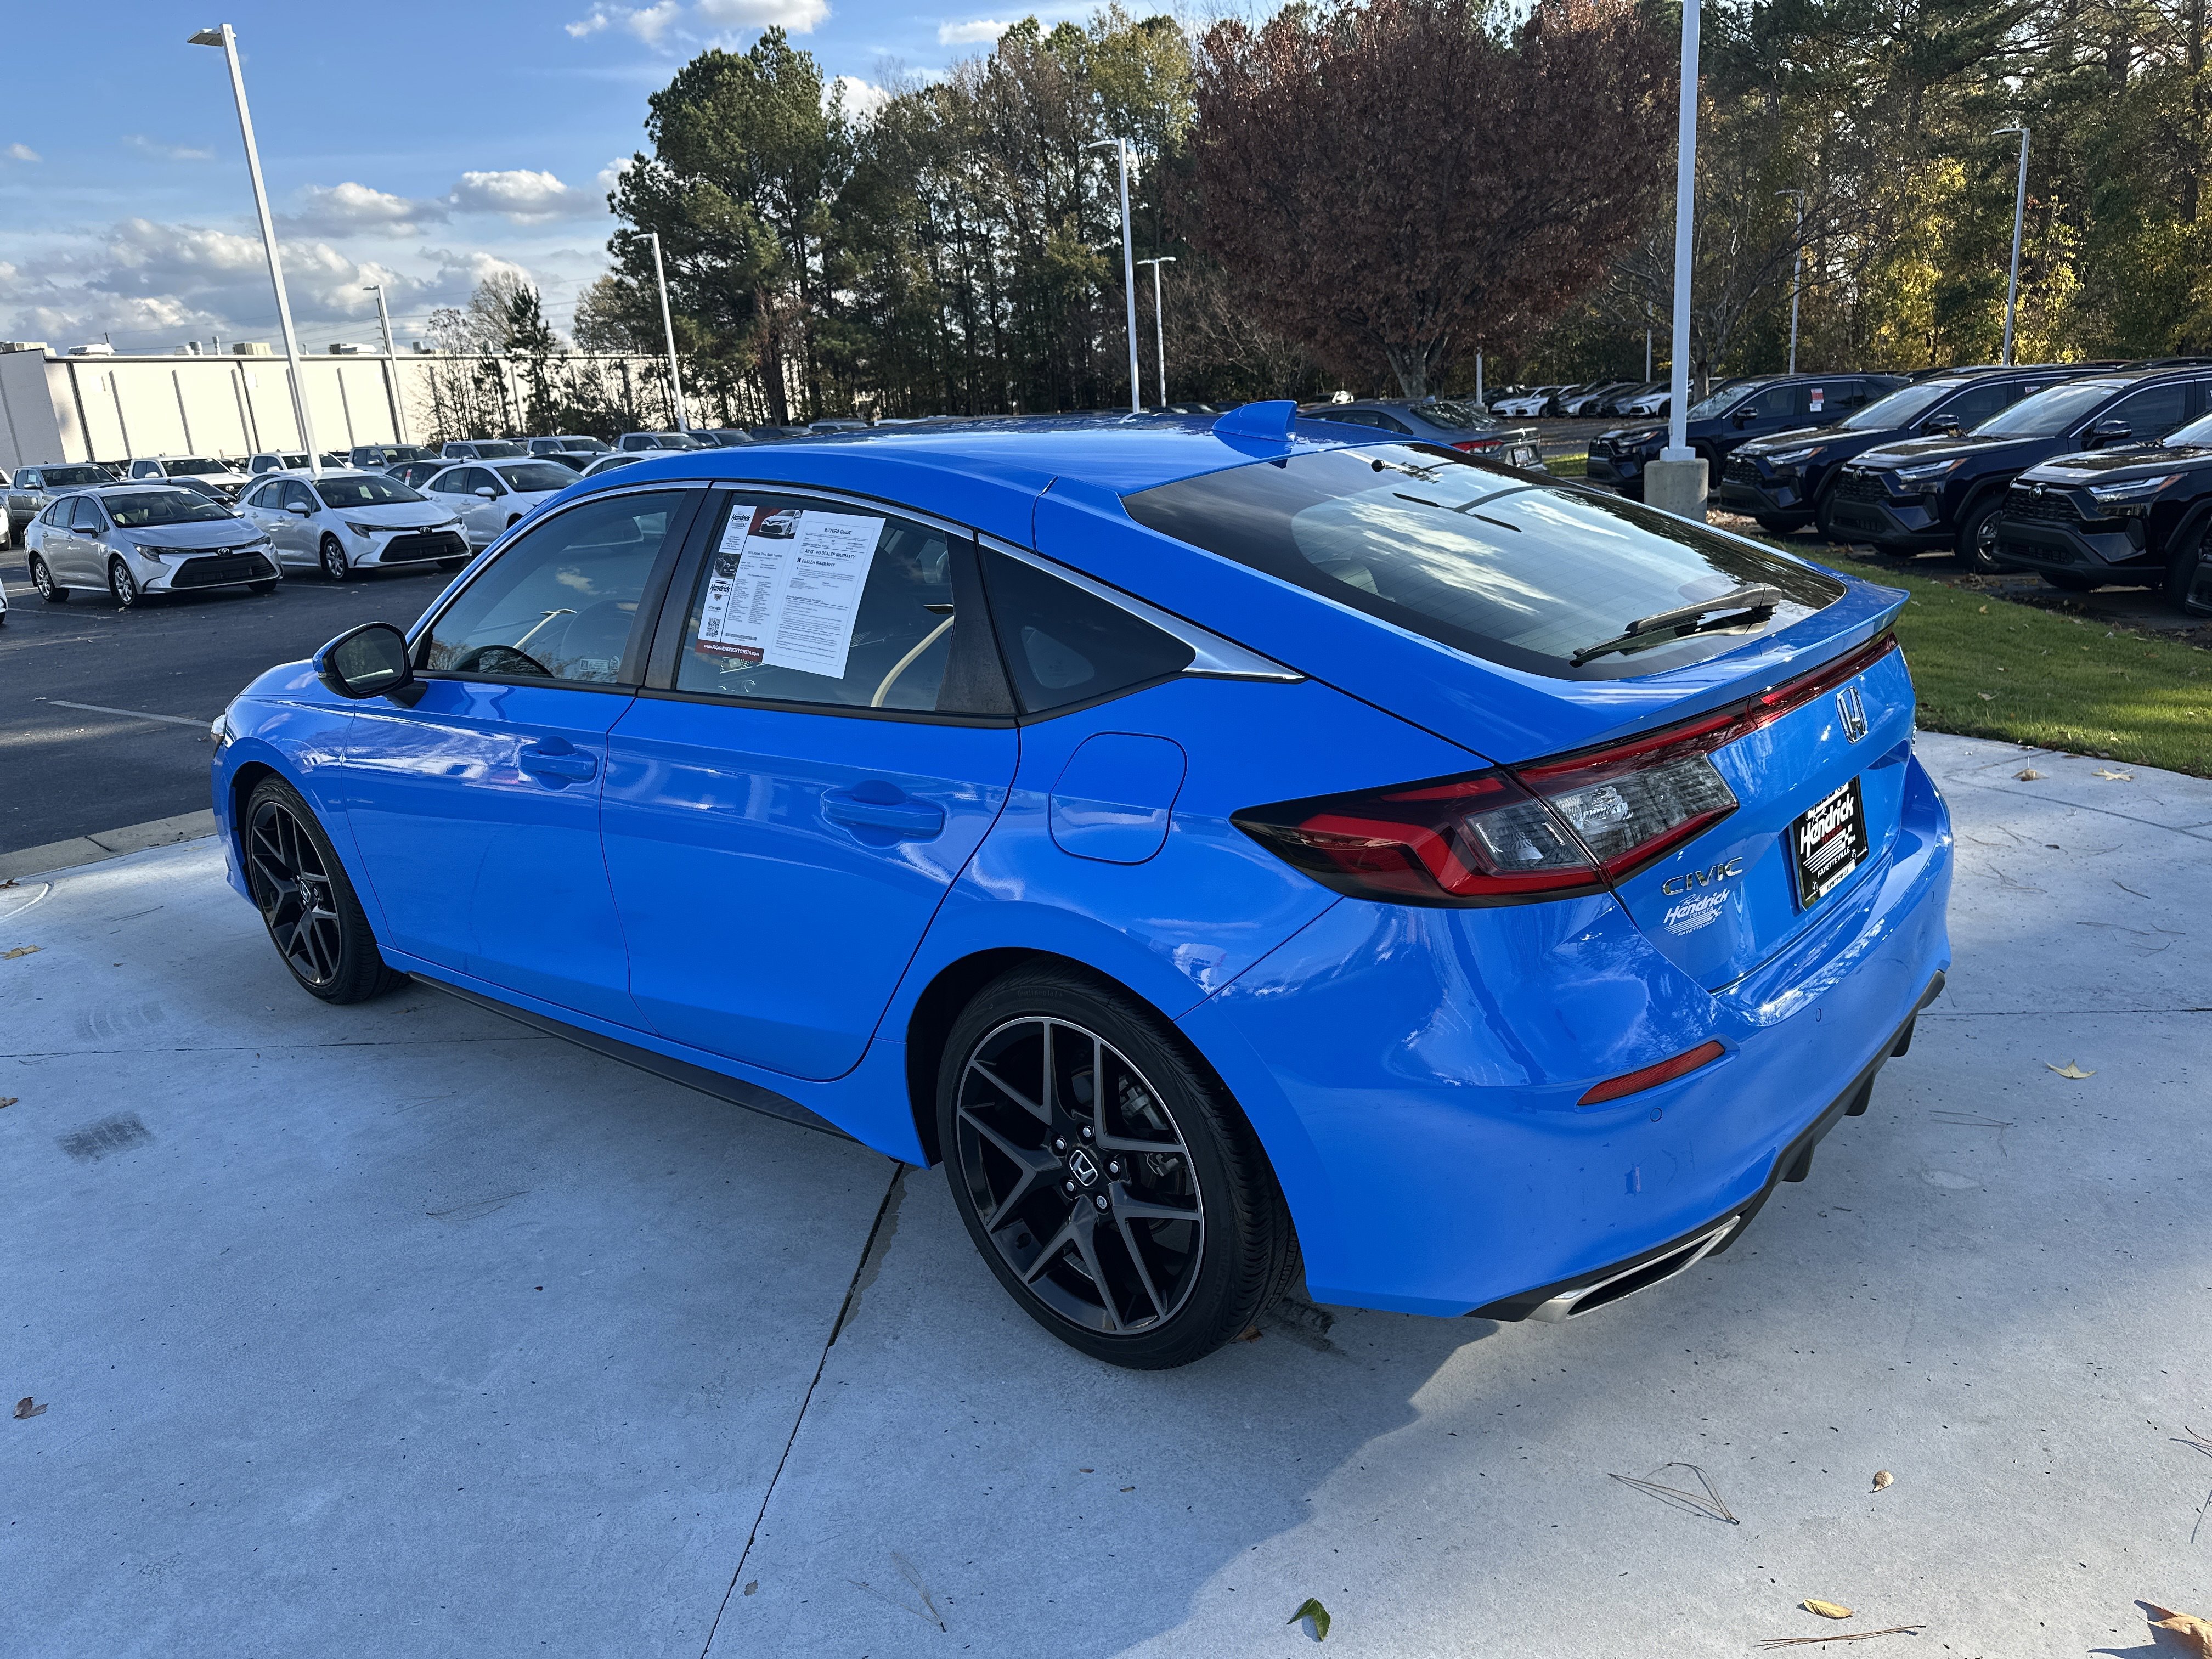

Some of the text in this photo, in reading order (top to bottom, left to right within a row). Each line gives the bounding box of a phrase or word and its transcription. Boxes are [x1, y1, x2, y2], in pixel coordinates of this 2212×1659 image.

[1800, 793, 1854, 859] Hendrick
[1821, 825, 1842, 845] TOYOTA
[1662, 856, 1743, 896] CIVIC
[1817, 845, 1851, 878] FAYETTEVILLE
[1663, 888, 1730, 926] Hendrick
[1689, 906, 1714, 919] TOYOTA
[1677, 918, 1716, 937] FAYETTEVILLE
